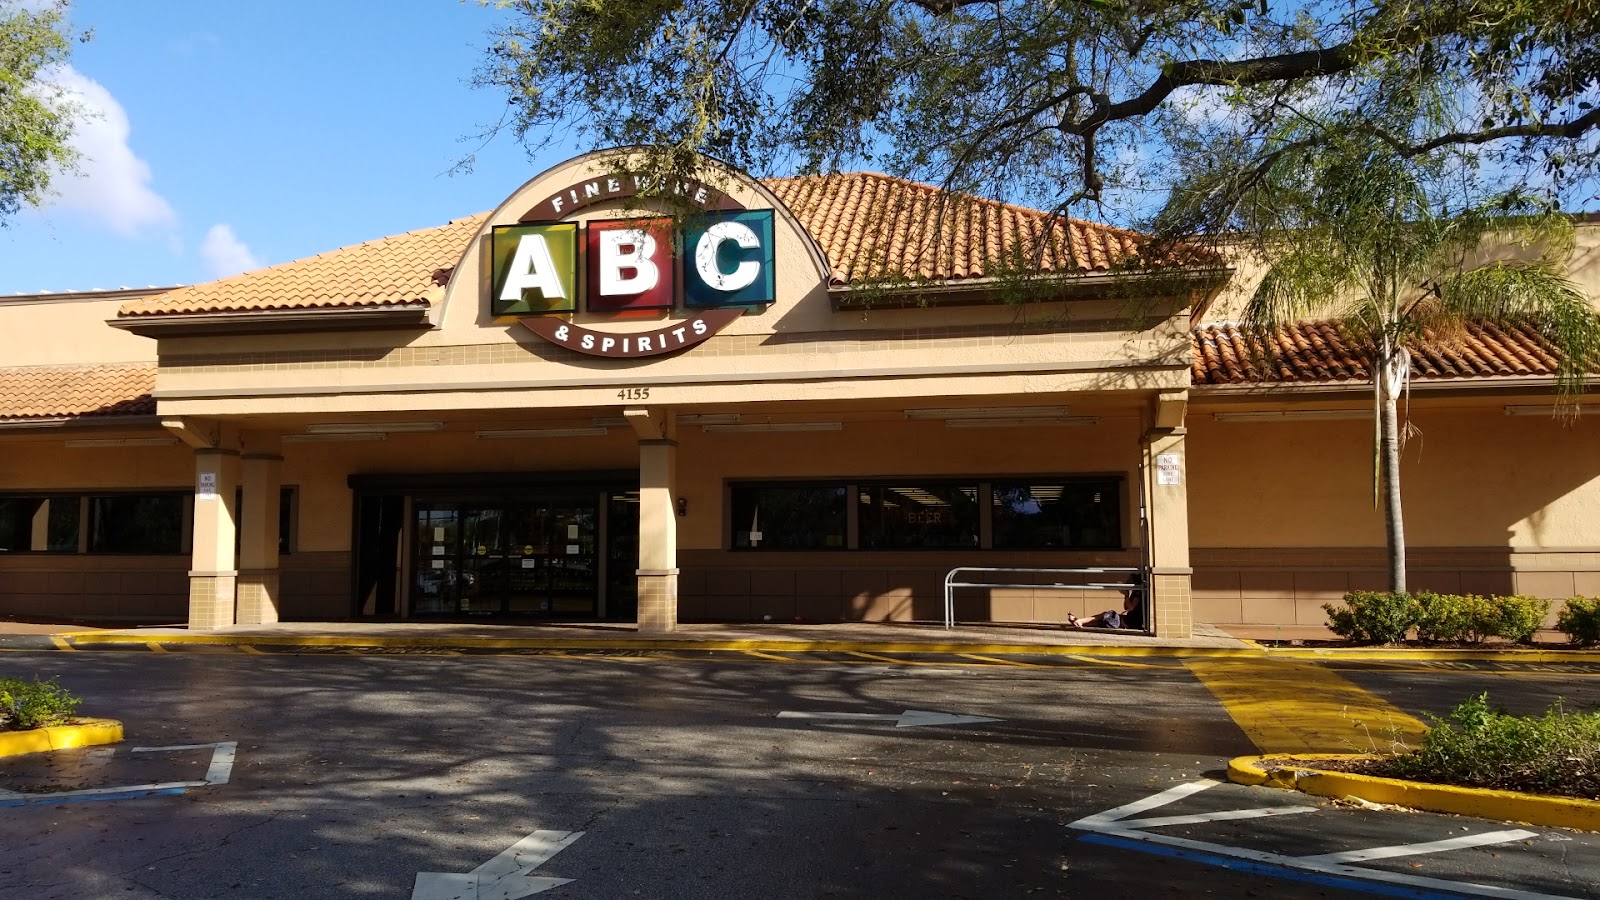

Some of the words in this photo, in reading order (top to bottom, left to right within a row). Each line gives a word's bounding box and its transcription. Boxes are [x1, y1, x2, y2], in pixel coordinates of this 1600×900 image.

[551, 177, 620, 213] FINE
[499, 221, 761, 301] ABC
[554, 325, 569, 342] &
[581, 319, 707, 353] SPIRITS
[617, 387, 650, 400] 4155
[908, 512, 942, 524] BEER
